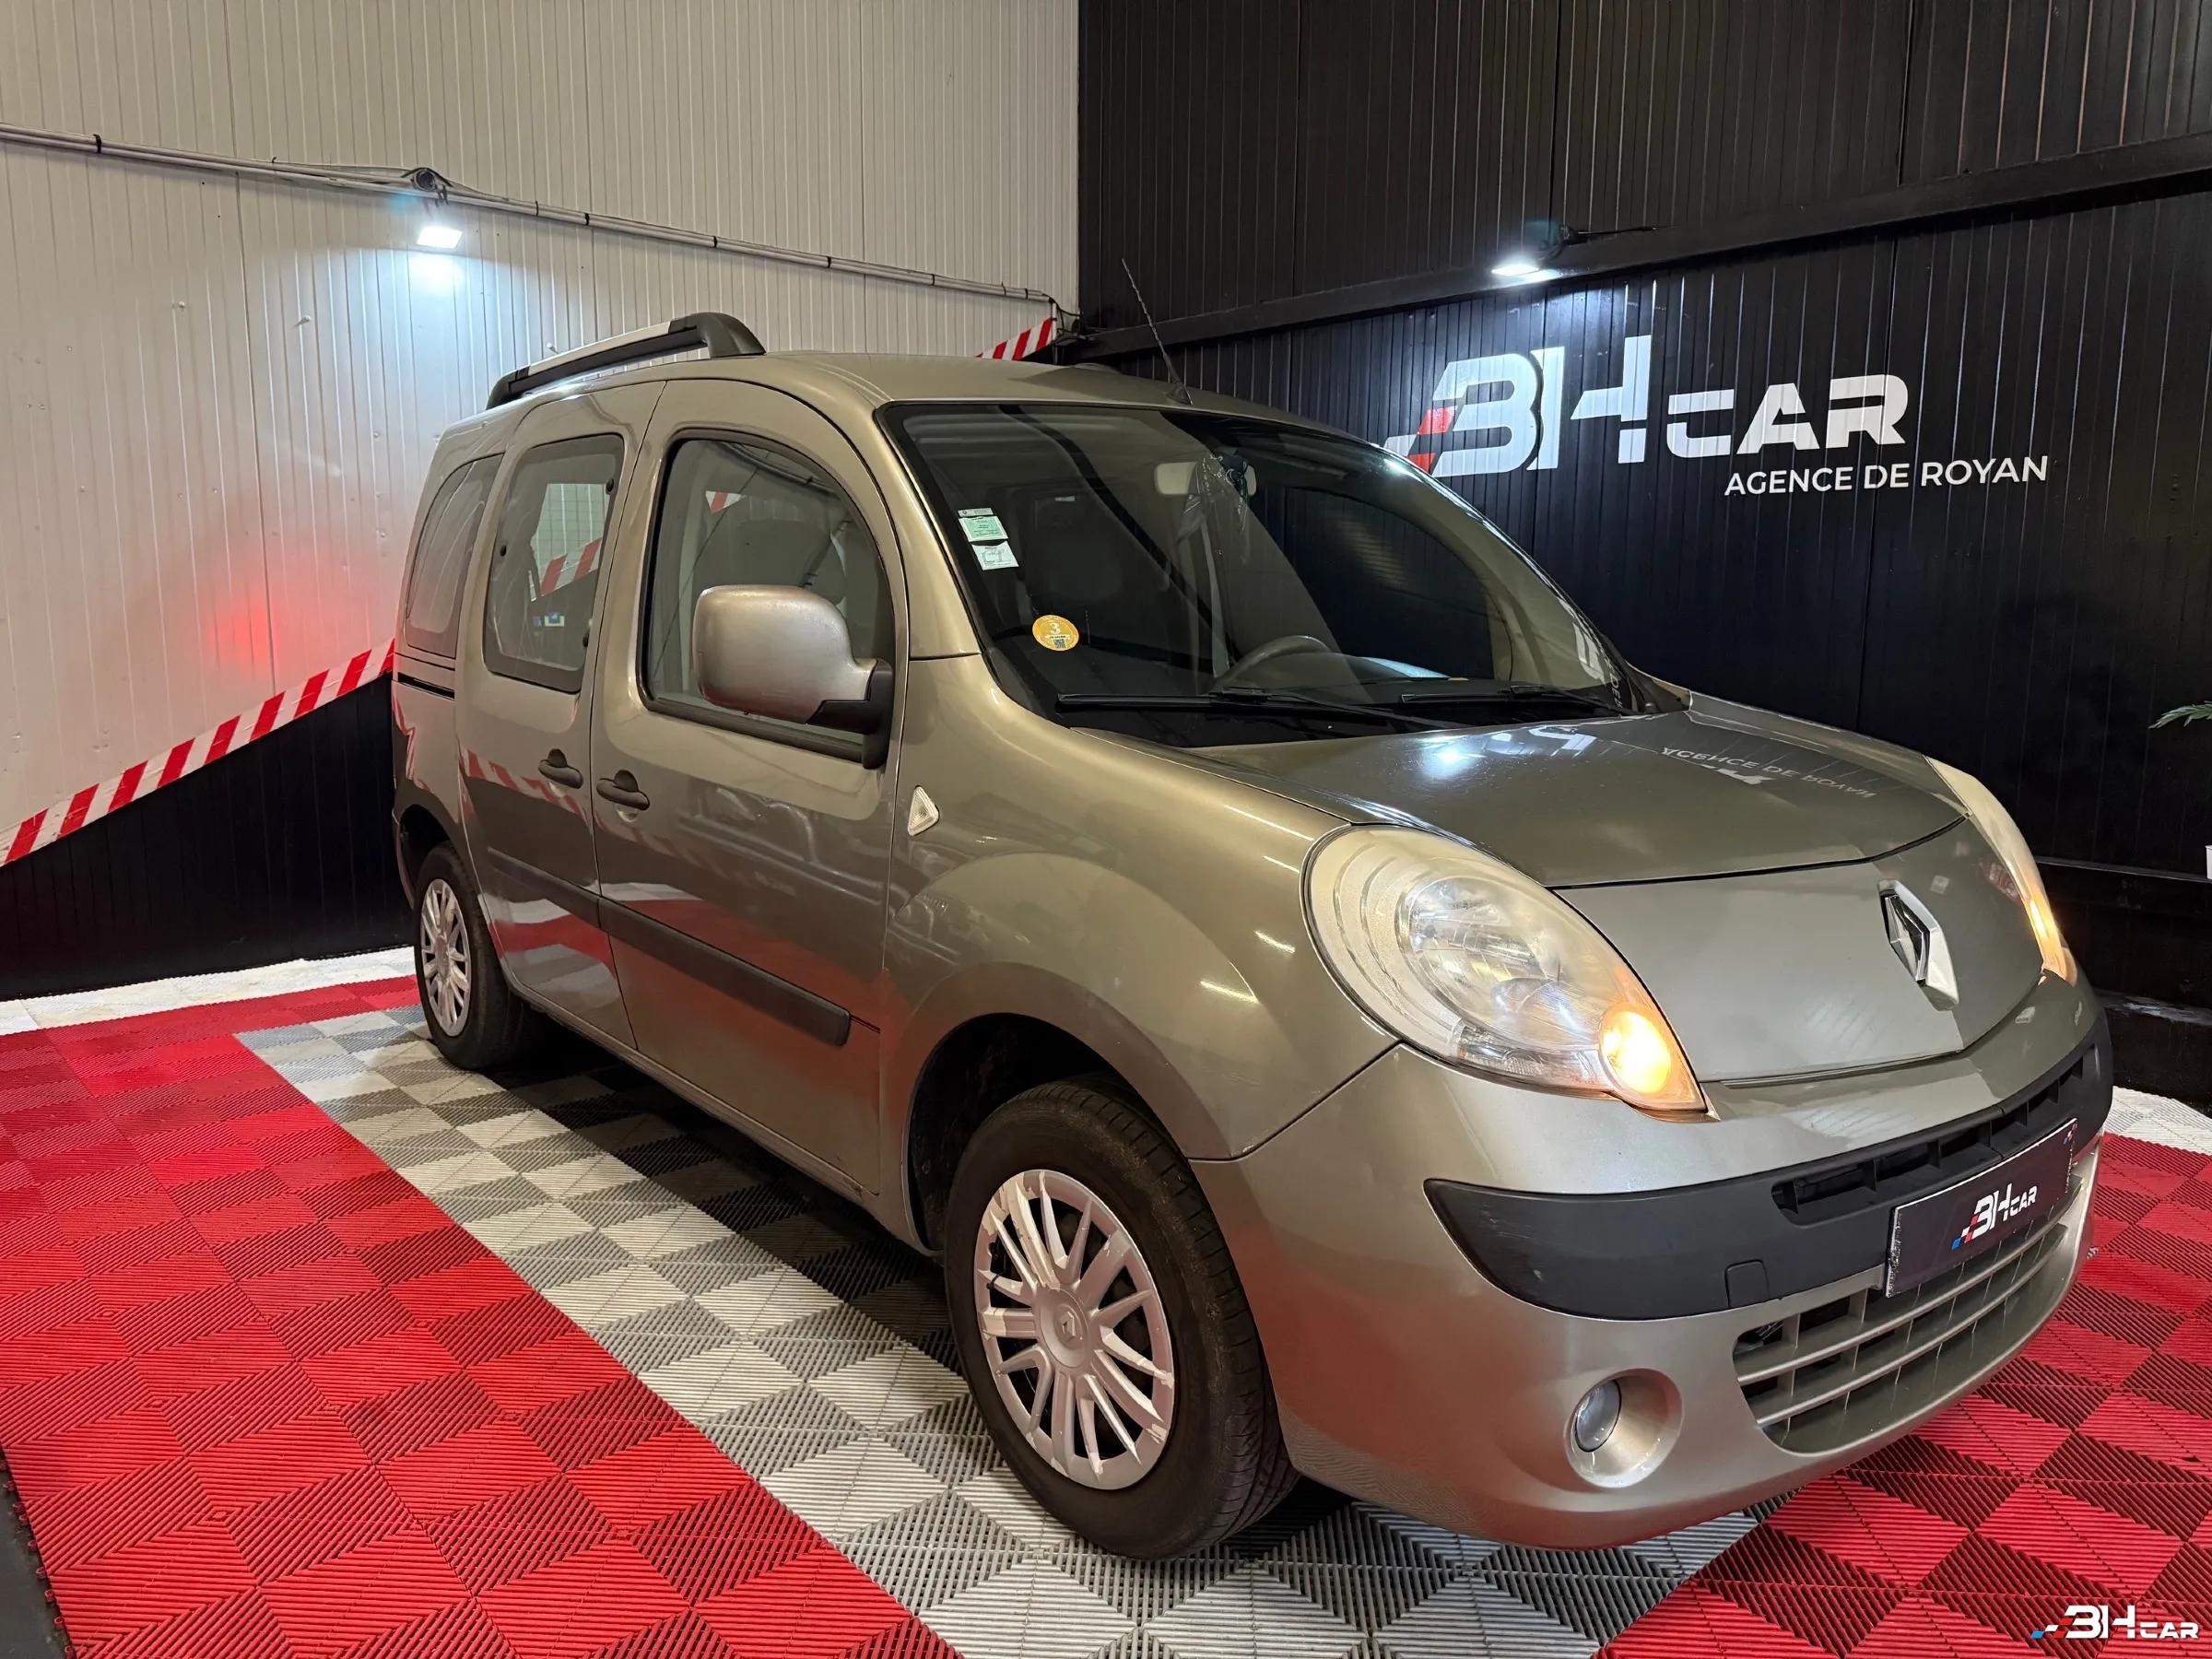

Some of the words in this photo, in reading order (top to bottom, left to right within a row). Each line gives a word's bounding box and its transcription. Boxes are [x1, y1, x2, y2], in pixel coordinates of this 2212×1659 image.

[1724, 465, 1854, 496] AGENCE
[1864, 463, 1911, 489] DE
[1921, 455, 2049, 487] ROYAN
